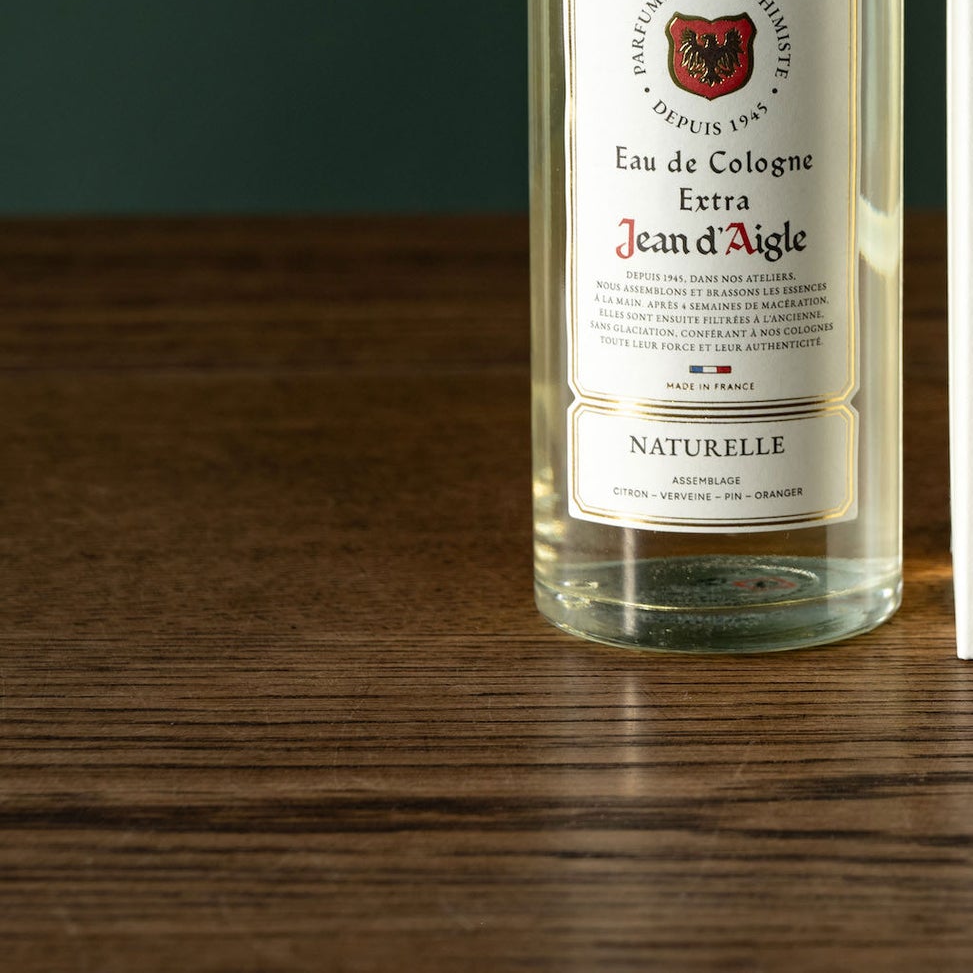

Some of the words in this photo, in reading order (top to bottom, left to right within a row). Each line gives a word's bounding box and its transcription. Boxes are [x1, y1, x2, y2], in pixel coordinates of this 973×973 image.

[651, 99, 722, 136] DEPUIS
[730, 102, 768, 133] 1945
[615, 145, 656, 172] Eau
[667, 150, 697, 173] de
[709, 150, 814, 178] Cologne
[679, 187, 750, 212] Extra
[615, 218, 691, 260] Jean
[696, 220, 807, 263] d'Aigle
[626, 270, 661, 281] DEPUIS
[690, 275, 719, 283] DANS
[721, 275, 743, 283] NOS
[596, 280, 620, 291] NOUS
[623, 285, 687, 296] ASSEMBLONS
[690, 289, 704, 297] ET
[706, 288, 760, 297] BRASSONS
[763, 288, 780, 296] LES
[783, 282, 827, 295] ESSENCES
[602, 295, 613, 304] LA
[647, 300, 678, 309] APRÈS
[689, 302, 742, 311] SEMAINES
[745, 302, 758, 310] DE
[599, 308, 624, 319] ELLES
[626, 312, 653, 322] SONT
[656, 314, 700, 324] ENSUITE
[703, 314, 751, 324] FILTRÉES
[753, 314, 760, 324] À
[590, 320, 611, 331] SANS
[680, 329, 747, 338] CONFÉRANT
[750, 328, 757, 338] À
[760, 328, 781, 337] NOS
[783, 322, 834, 336] COLOGNES
[600, 335, 630, 347] TOUTE
[633, 340, 658, 350] LEUR
[661, 342, 695, 351] FORCE
[699, 344, 712, 352] ET
[715, 344, 742, 352] LEUR
[666, 382, 694, 391] MADE
[699, 382, 709, 391] IN
[715, 382, 755, 391] FRANCE
[629, 435, 786, 458] NATURELLE
[672, 476, 741, 485] ASSEMBLAGE
[613, 486, 648, 499] CITRON
[660, 492, 712, 501] VERVEINE
[724, 492, 742, 500] PIN
[755, 488, 803, 499] ORANGER
